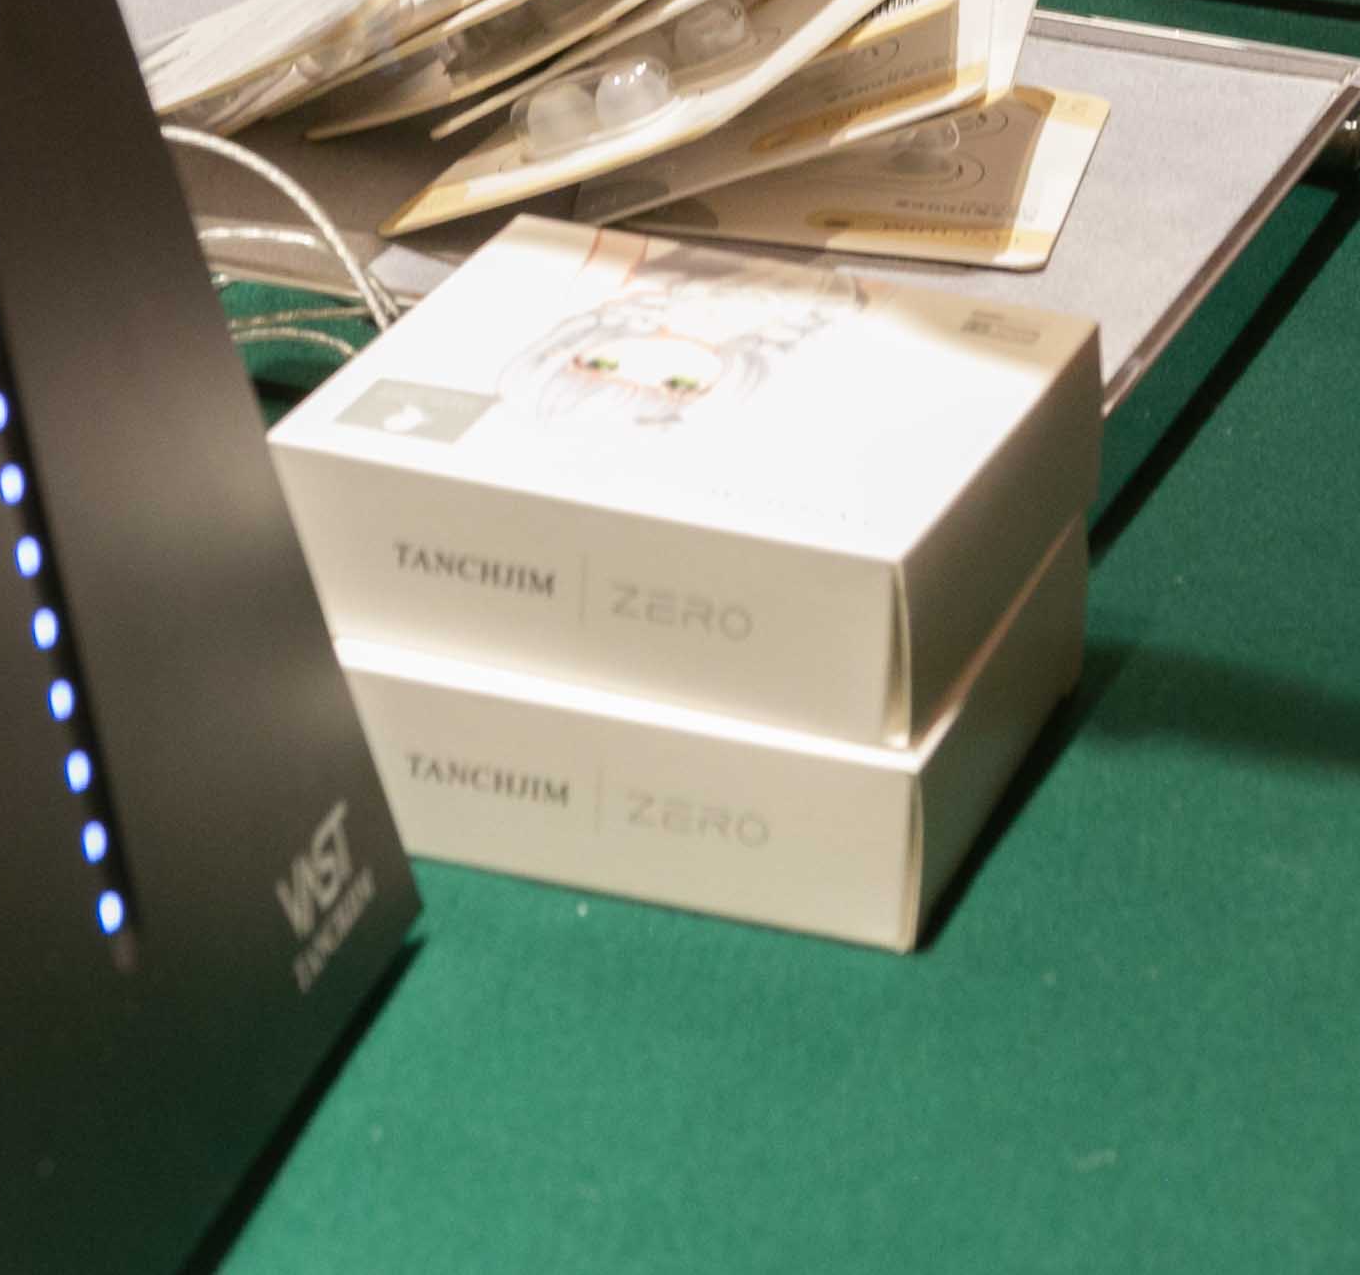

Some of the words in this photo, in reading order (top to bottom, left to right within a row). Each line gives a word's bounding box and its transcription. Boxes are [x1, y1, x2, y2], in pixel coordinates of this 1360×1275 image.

[393, 541, 557, 598] TANCHJIM
[610, 581, 754, 642] ZERO
[407, 752, 571, 808] TANCHJIM
[627, 790, 770, 848] ZERO
